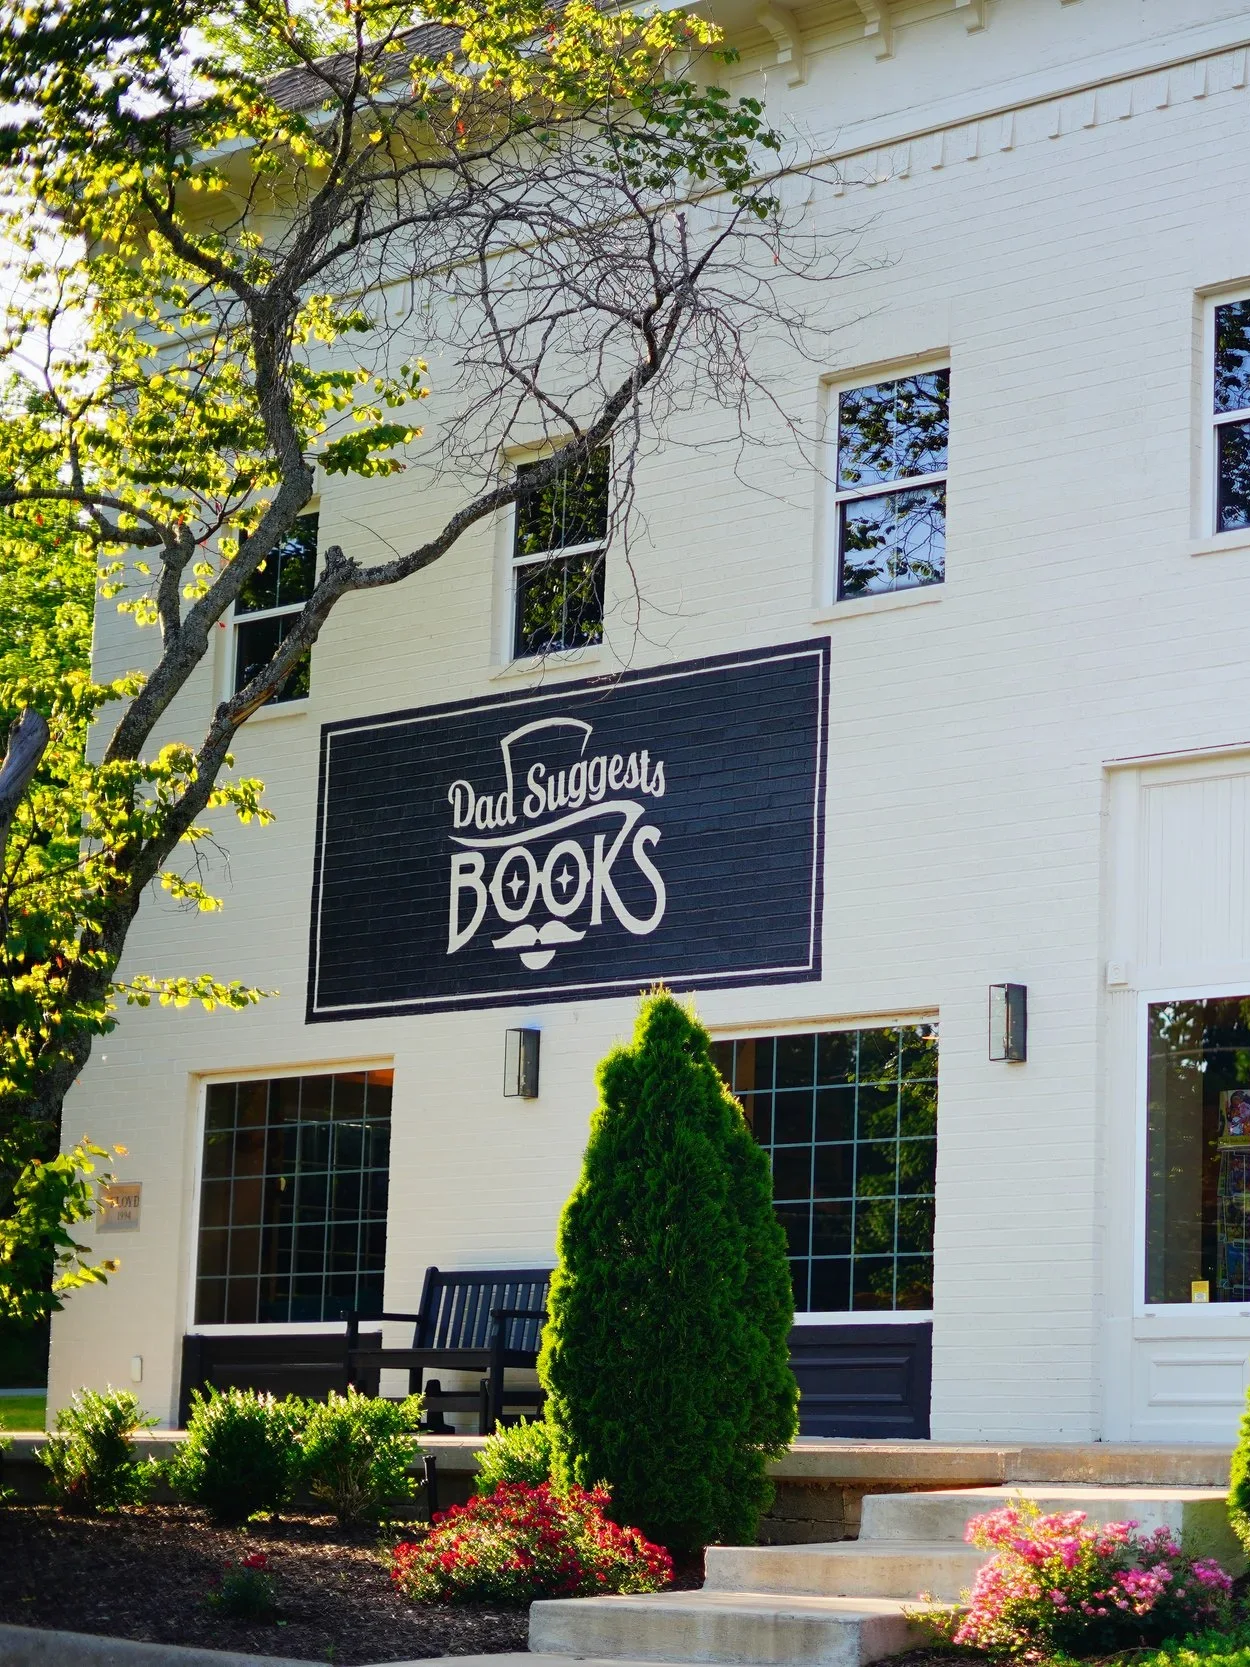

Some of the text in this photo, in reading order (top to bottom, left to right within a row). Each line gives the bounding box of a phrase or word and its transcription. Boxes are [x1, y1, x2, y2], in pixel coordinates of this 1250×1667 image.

[448, 748, 666, 830] Dad Suggests
[447, 823, 666, 955] BOOKS
[109, 1195, 140, 1209] LOYD
